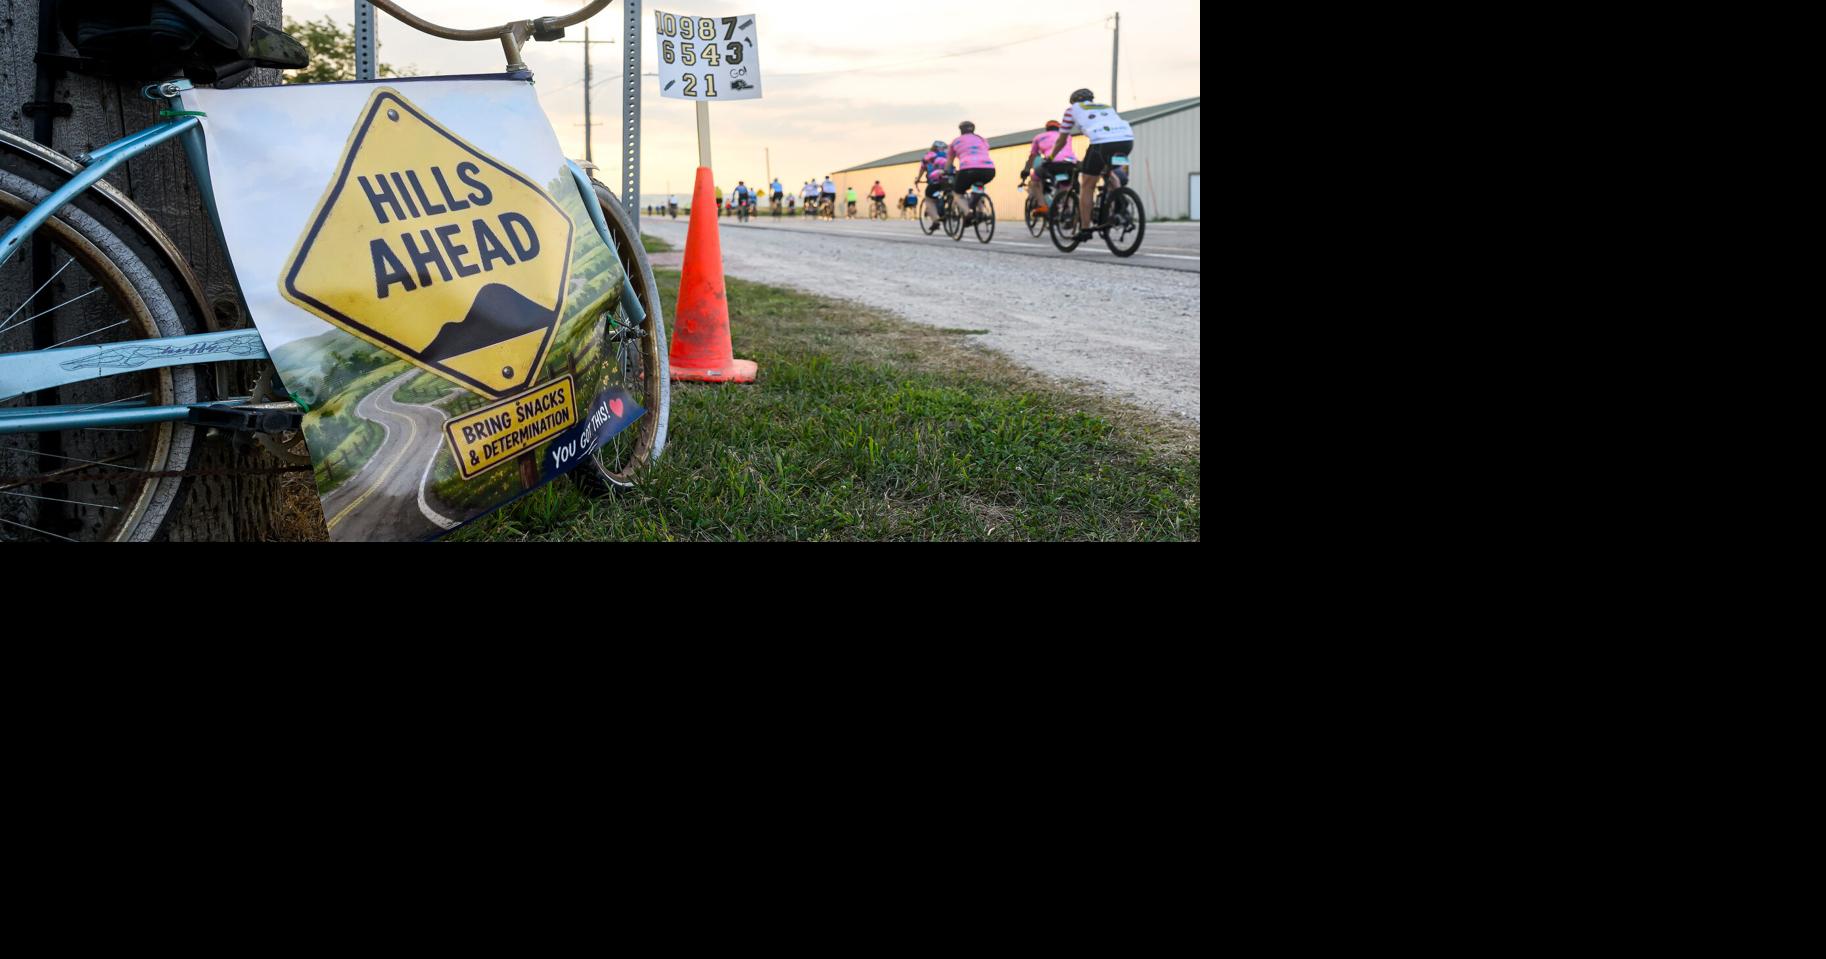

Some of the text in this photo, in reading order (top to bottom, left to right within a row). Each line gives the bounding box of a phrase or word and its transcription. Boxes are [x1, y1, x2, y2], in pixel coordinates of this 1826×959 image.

[682, 73, 717, 97] 2 1
[357, 161, 493, 224] HILLS
[370, 212, 540, 299] AHEAD
[462, 388, 565, 444] BRING SNACKS
[469, 407, 569, 466] & DETERMINATION
[552, 401, 611, 469] YOU GOT THIS!
